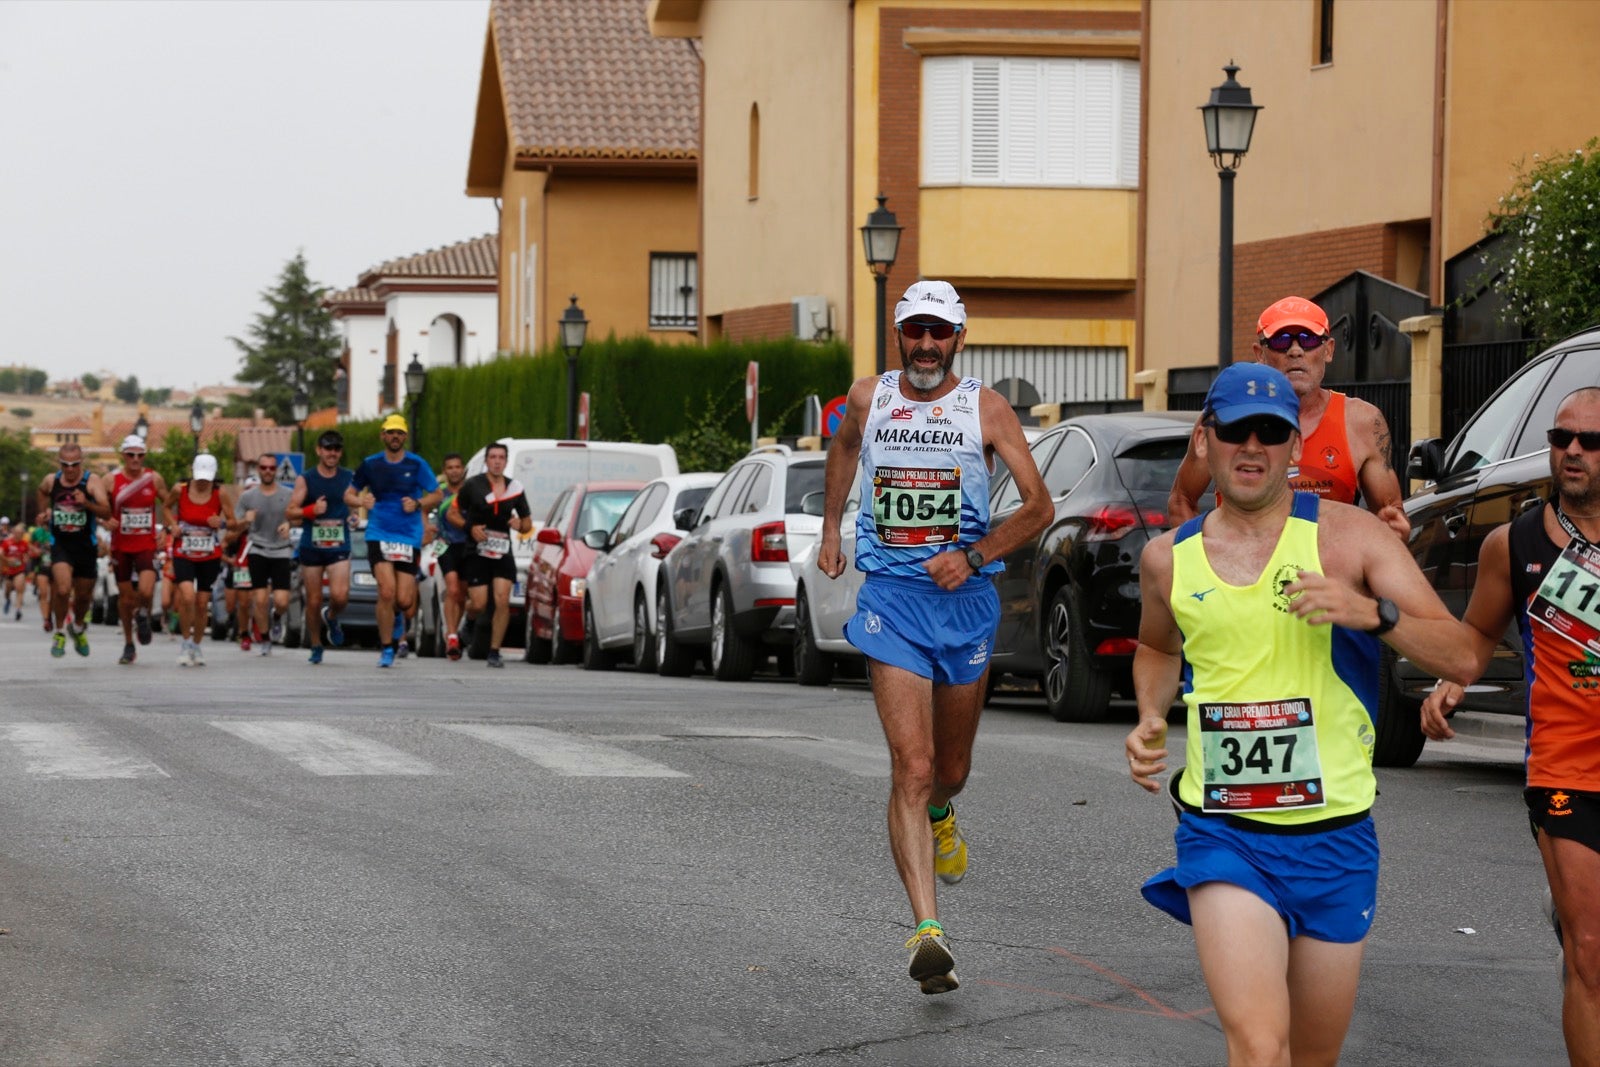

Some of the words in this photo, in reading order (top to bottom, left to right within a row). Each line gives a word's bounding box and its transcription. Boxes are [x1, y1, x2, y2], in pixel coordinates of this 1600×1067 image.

[874, 428, 964, 446] MARACENA
[891, 469, 906, 480] GRAN
[906, 471, 928, 480] PREMIO
[929, 471, 936, 480] DE
[937, 471, 956, 481] FONDO
[879, 491, 958, 521] 1054
[125, 514, 149, 524] 3022
[319, 528, 339, 538] 939
[185, 538, 211, 549] 3037
[1555, 569, 1600, 616] 11
[1224, 705, 1242, 718] GRAN
[1241, 704, 1270, 718] PREMIO
[1271, 704, 1281, 716] DE
[1281, 701, 1306, 716] FONDO
[1254, 718, 1288, 729] CRUZCAMPO
[1220, 734, 1298, 777] 347
